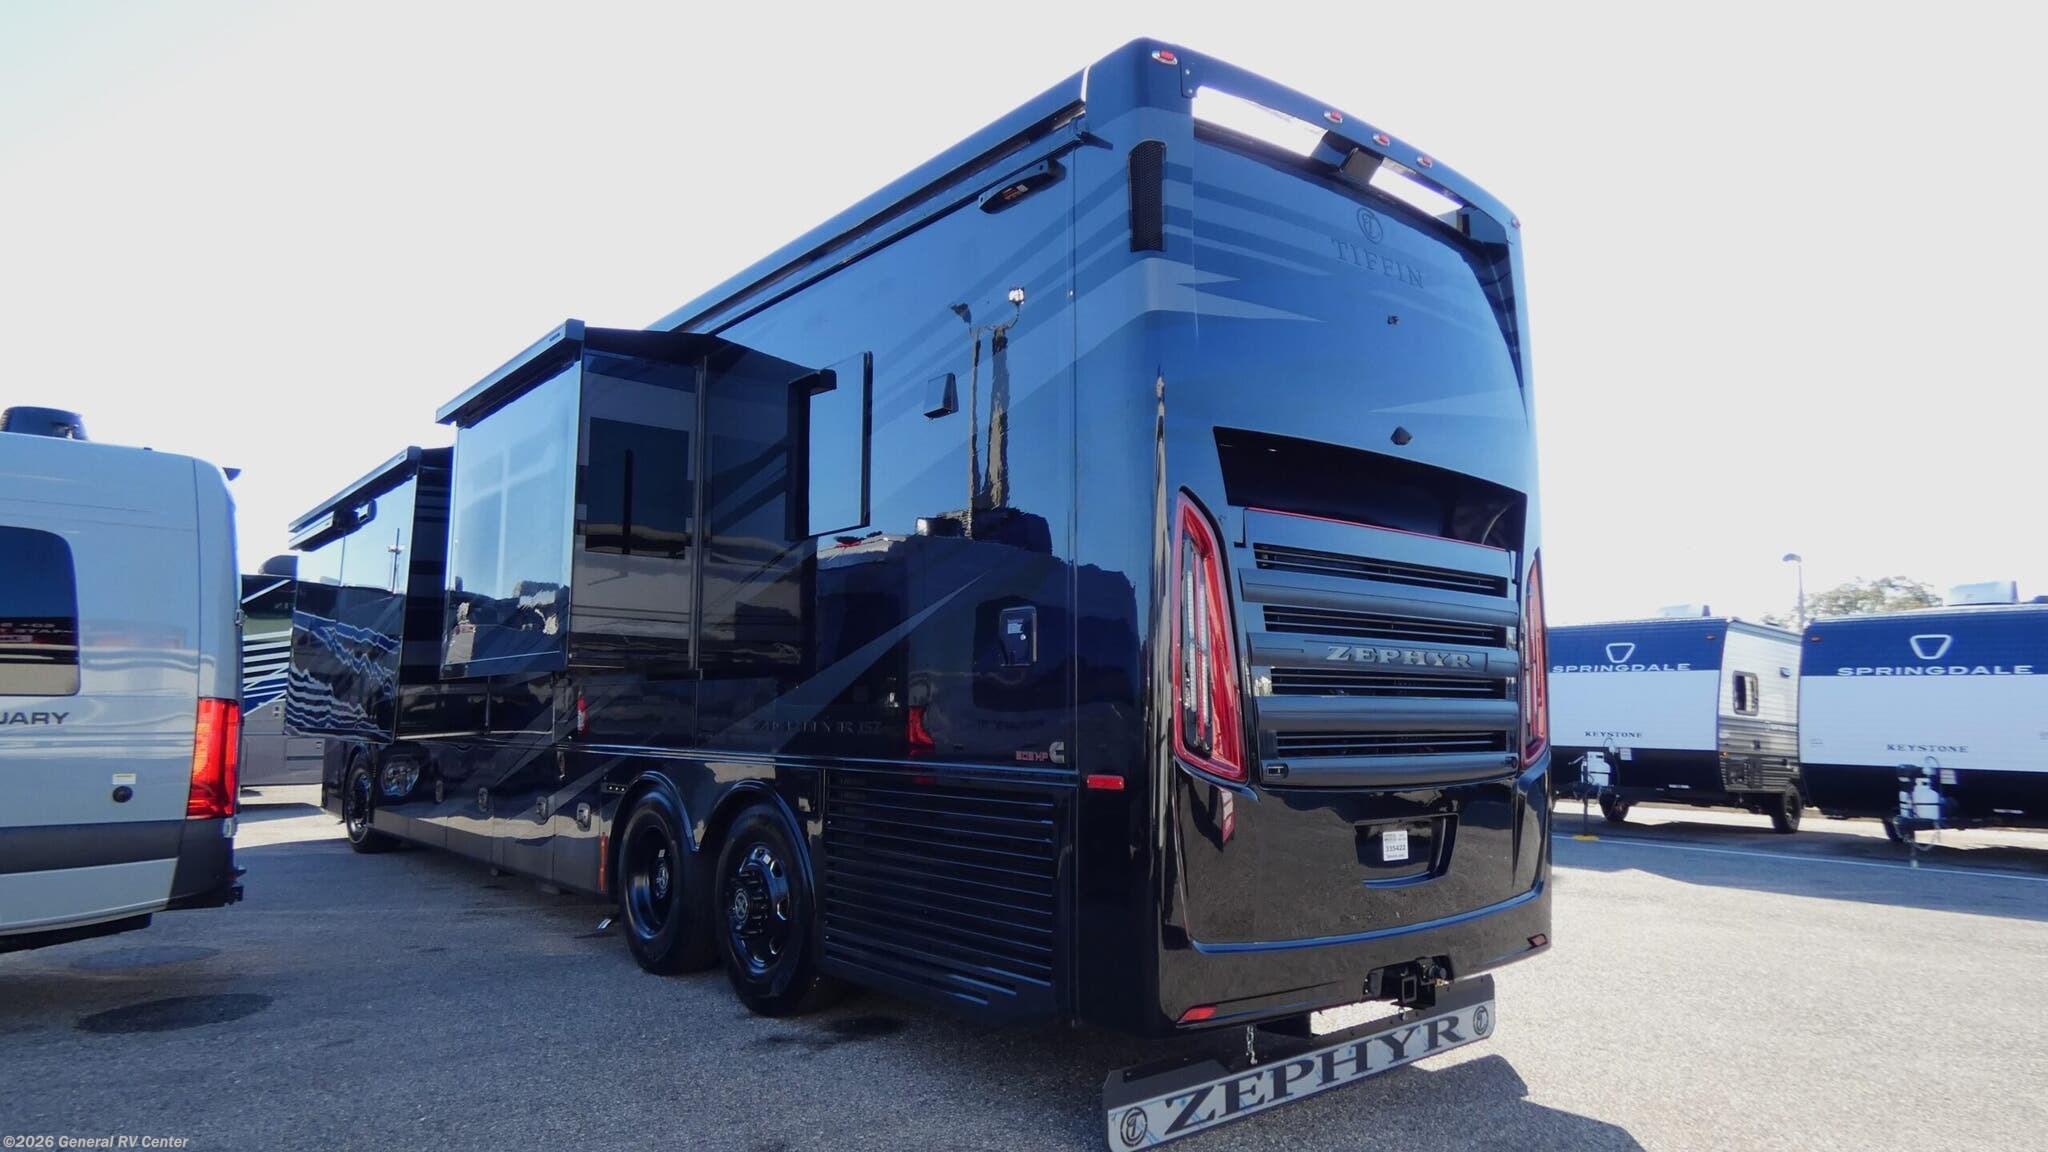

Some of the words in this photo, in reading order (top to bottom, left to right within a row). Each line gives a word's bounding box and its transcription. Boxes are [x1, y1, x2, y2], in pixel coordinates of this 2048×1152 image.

[1330, 236, 1424, 289] TIFFIN
[1326, 645, 1473, 668] ZEPHYR
[1552, 663, 1691, 673] SPRINGDALE
[1837, 664, 2035, 676] SPRINGDALE
[1584, 730, 1643, 739] KEYSTONE
[1886, 743, 1969, 754] KEYSTONE
[1164, 1014, 1466, 1136] ZEPHYR
